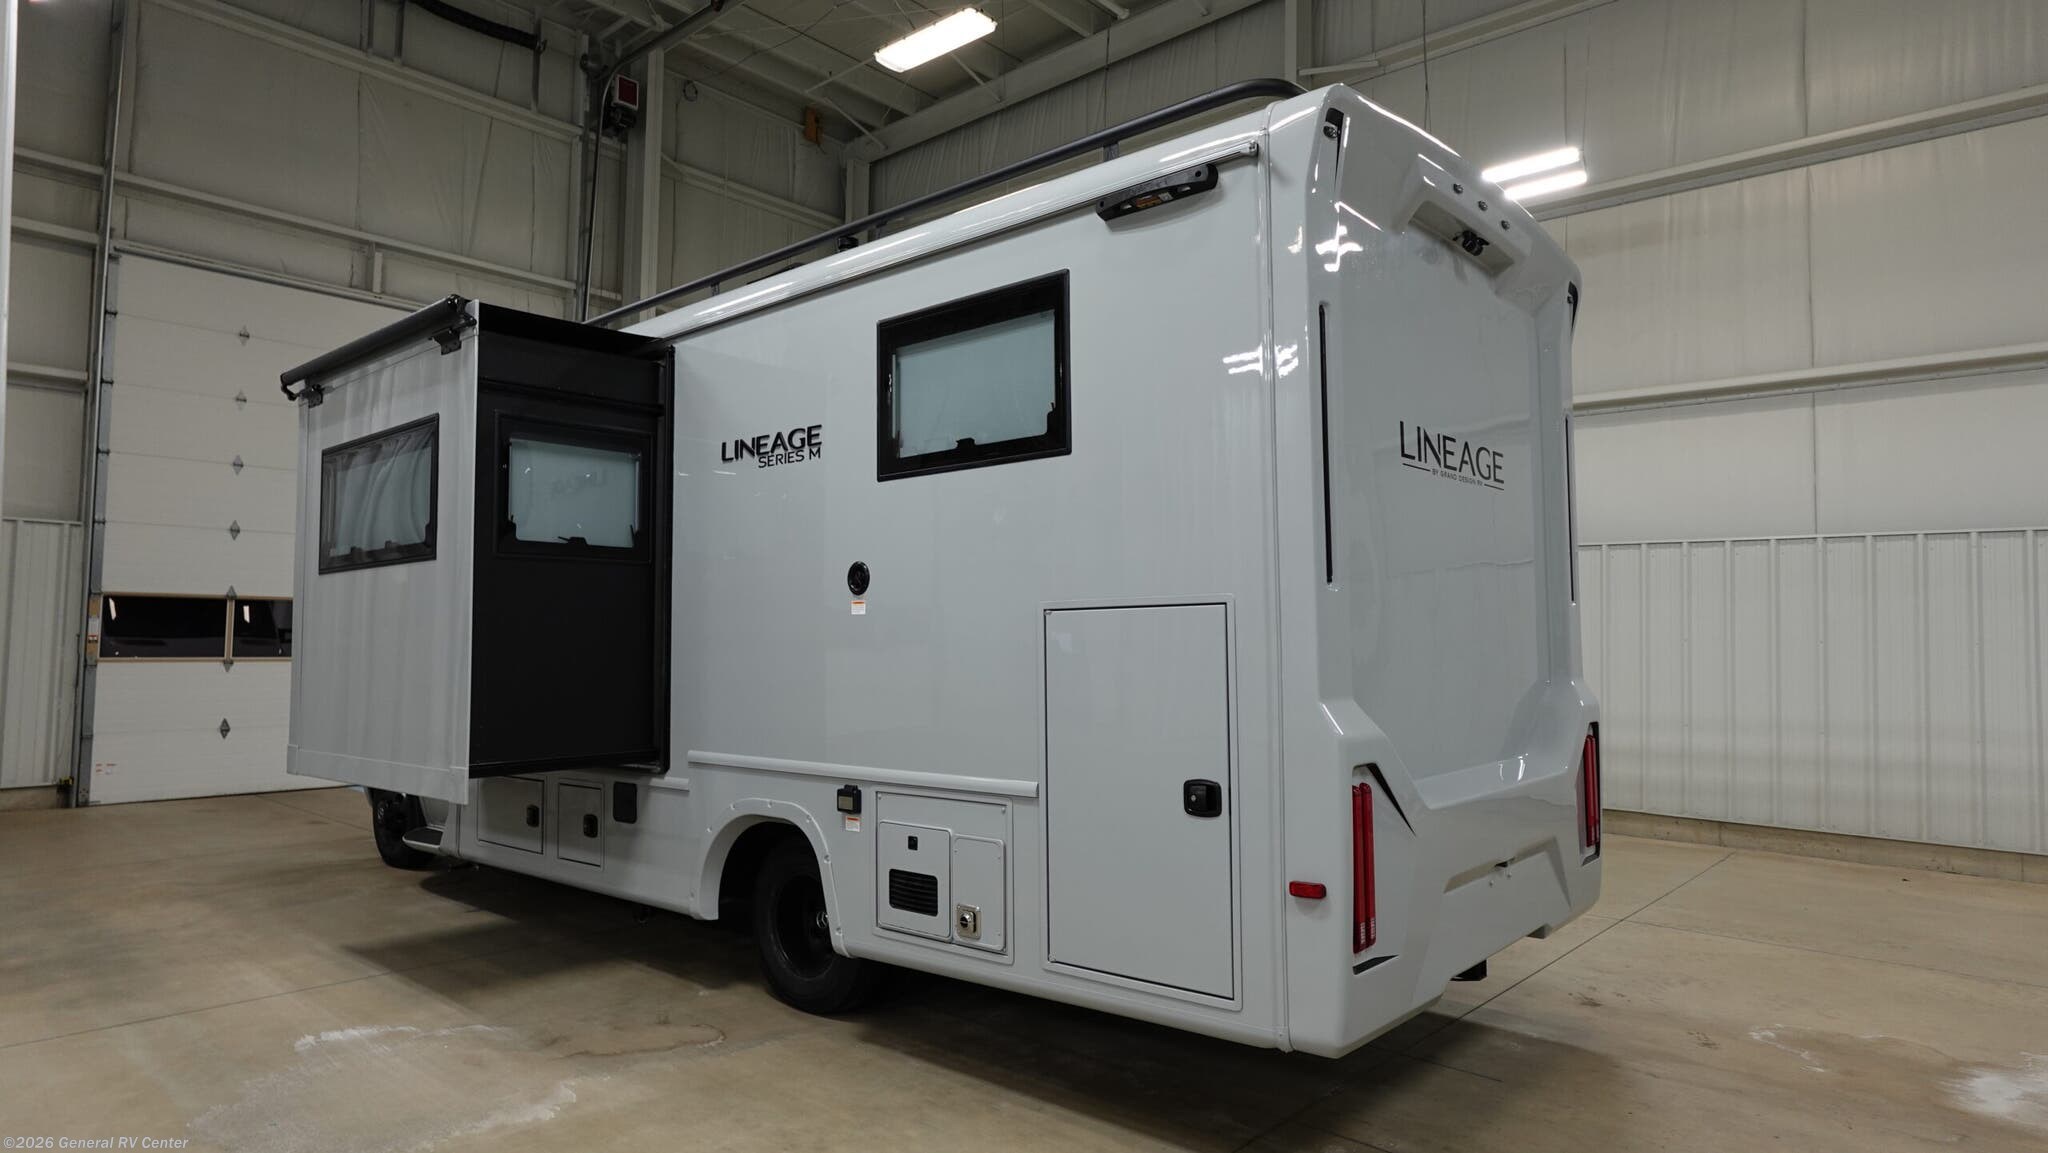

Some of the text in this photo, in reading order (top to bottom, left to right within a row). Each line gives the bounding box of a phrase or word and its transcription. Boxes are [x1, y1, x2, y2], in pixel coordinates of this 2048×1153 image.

[721, 424, 822, 463] LINEAGE
[758, 447, 821, 468] SERIES M
[1399, 420, 1505, 484] LINEAGE
[1440, 470, 1457, 481] GRAND
